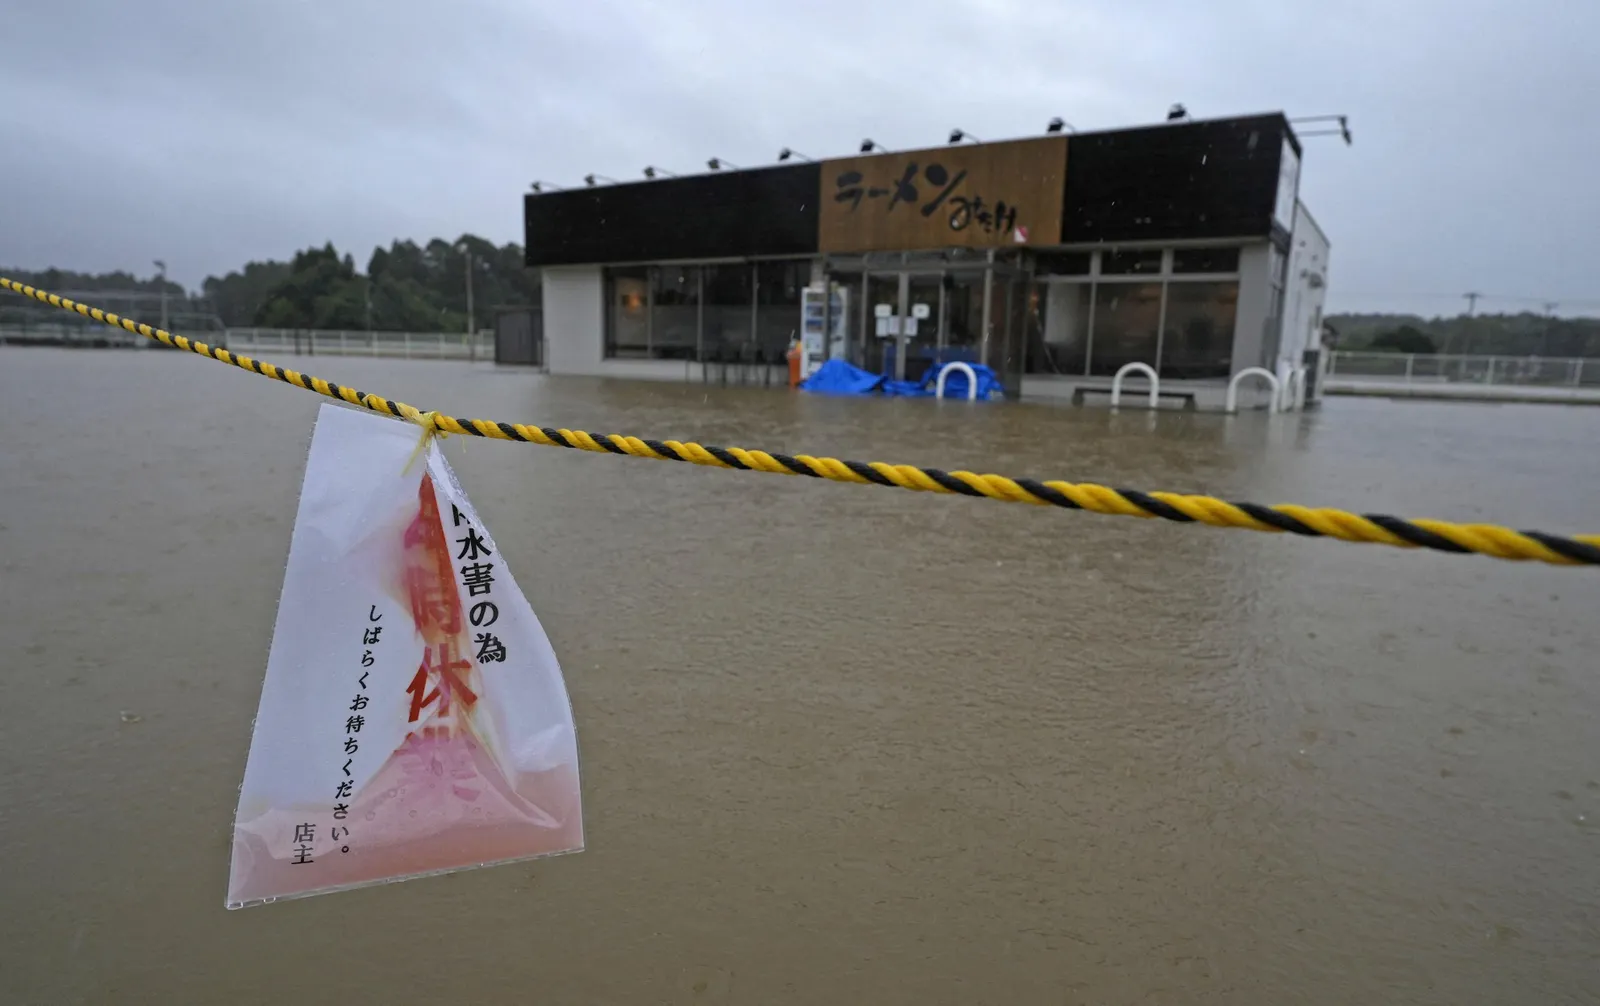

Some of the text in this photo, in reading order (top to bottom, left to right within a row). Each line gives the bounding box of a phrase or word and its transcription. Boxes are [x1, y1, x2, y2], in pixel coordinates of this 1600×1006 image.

[834, 162, 967, 217] ラーメン
[331, 604, 383, 854] しばらくお待ちください。
[291, 822, 316, 865] 店主
